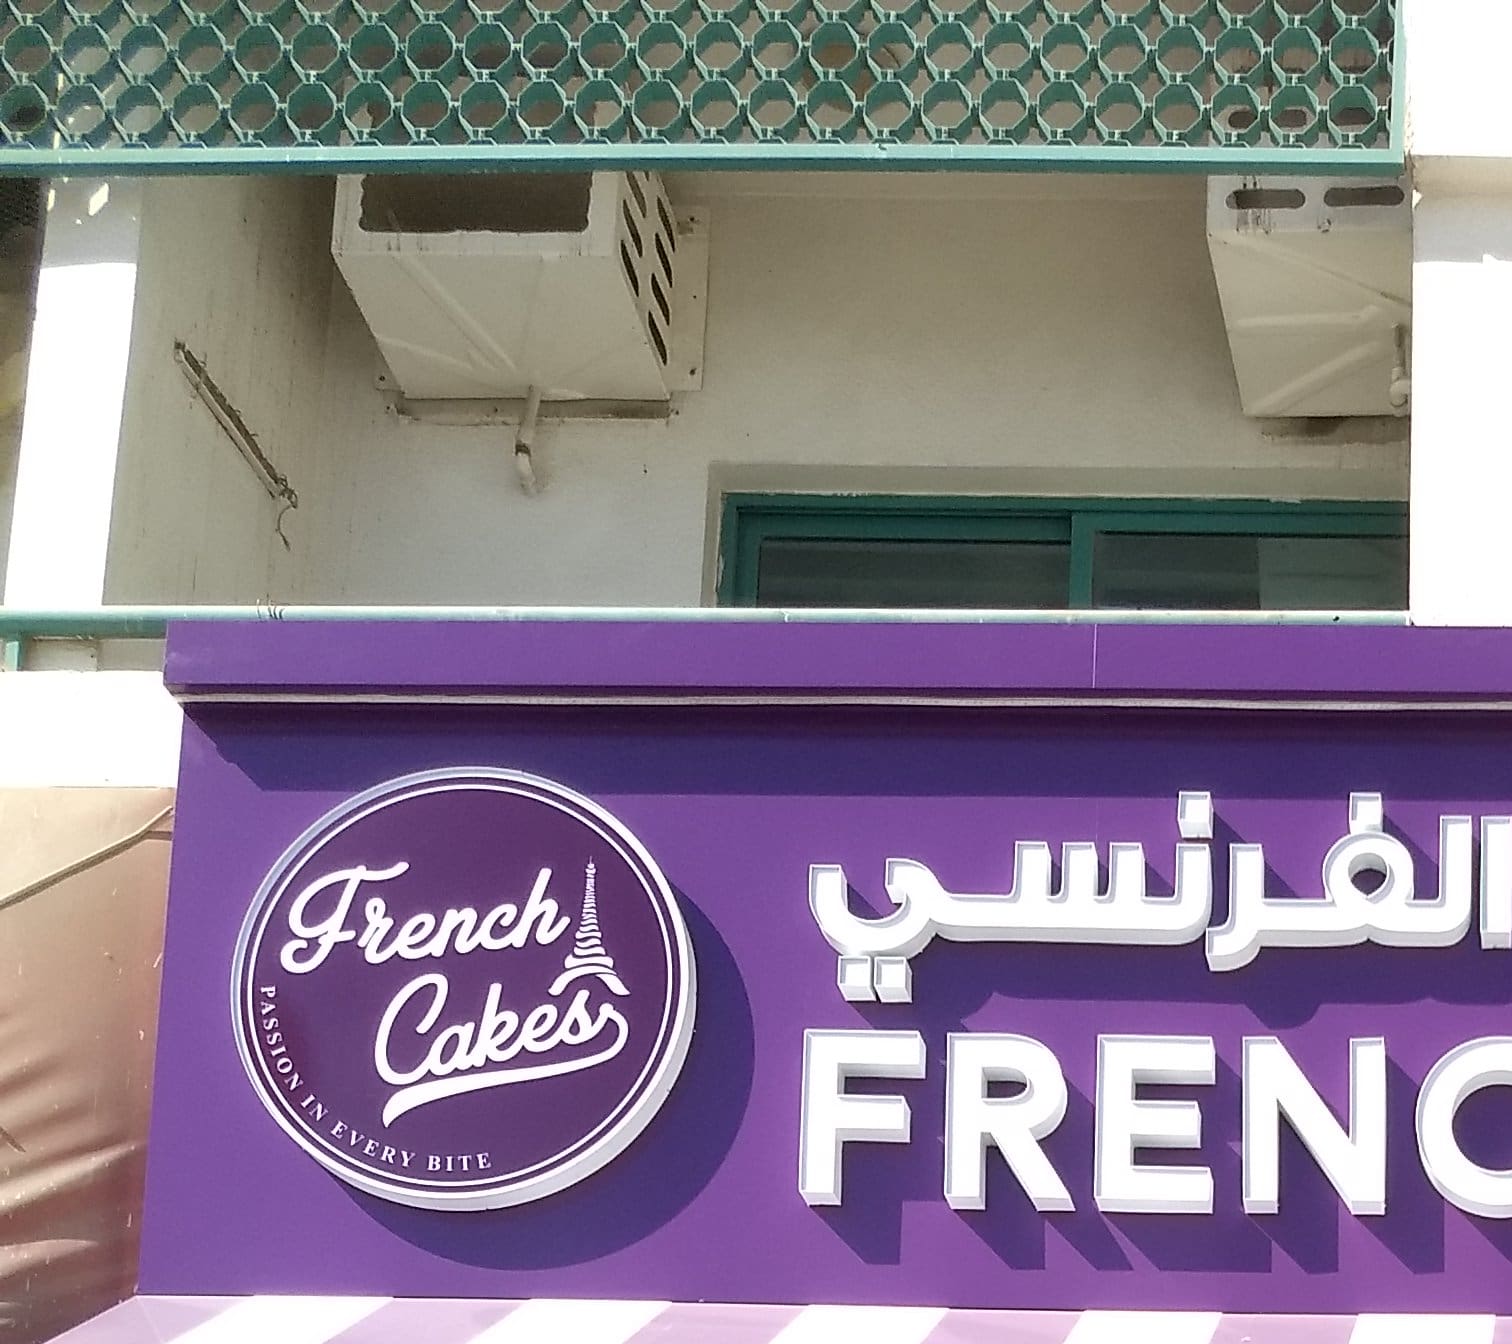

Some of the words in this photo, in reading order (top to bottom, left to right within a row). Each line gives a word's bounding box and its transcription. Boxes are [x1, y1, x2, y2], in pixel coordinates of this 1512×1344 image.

[280, 861, 571, 974] French
[808, 791, 1512, 1003] الفرنسي
[260, 985, 305, 1091] PASSION
[301, 1094, 329, 1122] IN
[331, 1121, 416, 1168] EVERY
[427, 1152, 493, 1172] BITE
[374, 972, 630, 1090] Cakes
